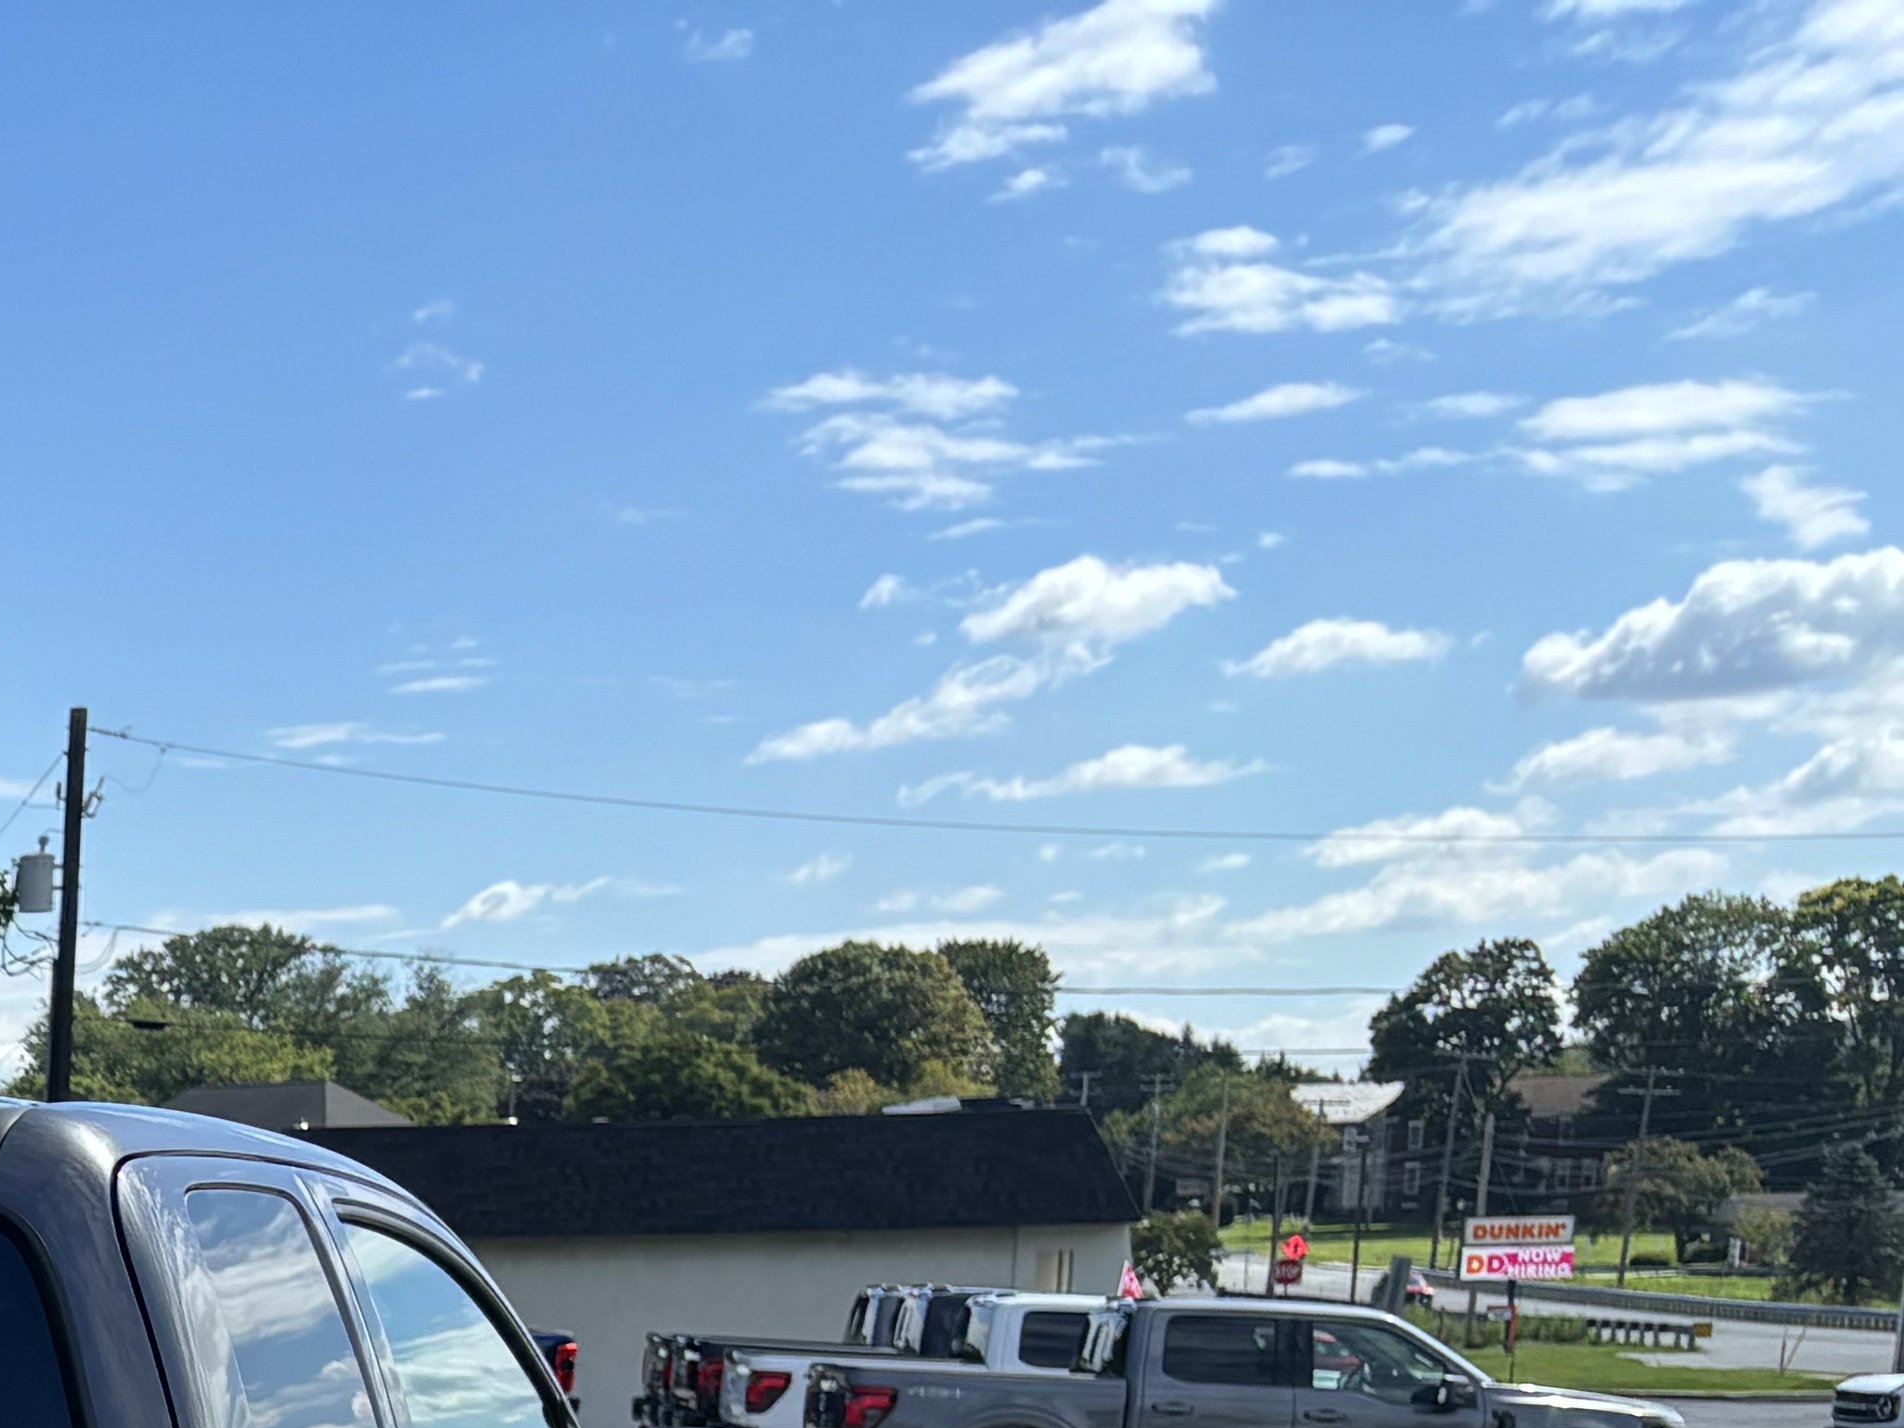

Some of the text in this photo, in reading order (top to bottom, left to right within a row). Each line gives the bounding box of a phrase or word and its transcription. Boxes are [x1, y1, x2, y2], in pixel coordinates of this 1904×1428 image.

[1517, 1246, 1563, 1263] NOW
[1275, 1264, 1300, 1278] STOP
[1507, 1263, 1572, 1278] HIRING
